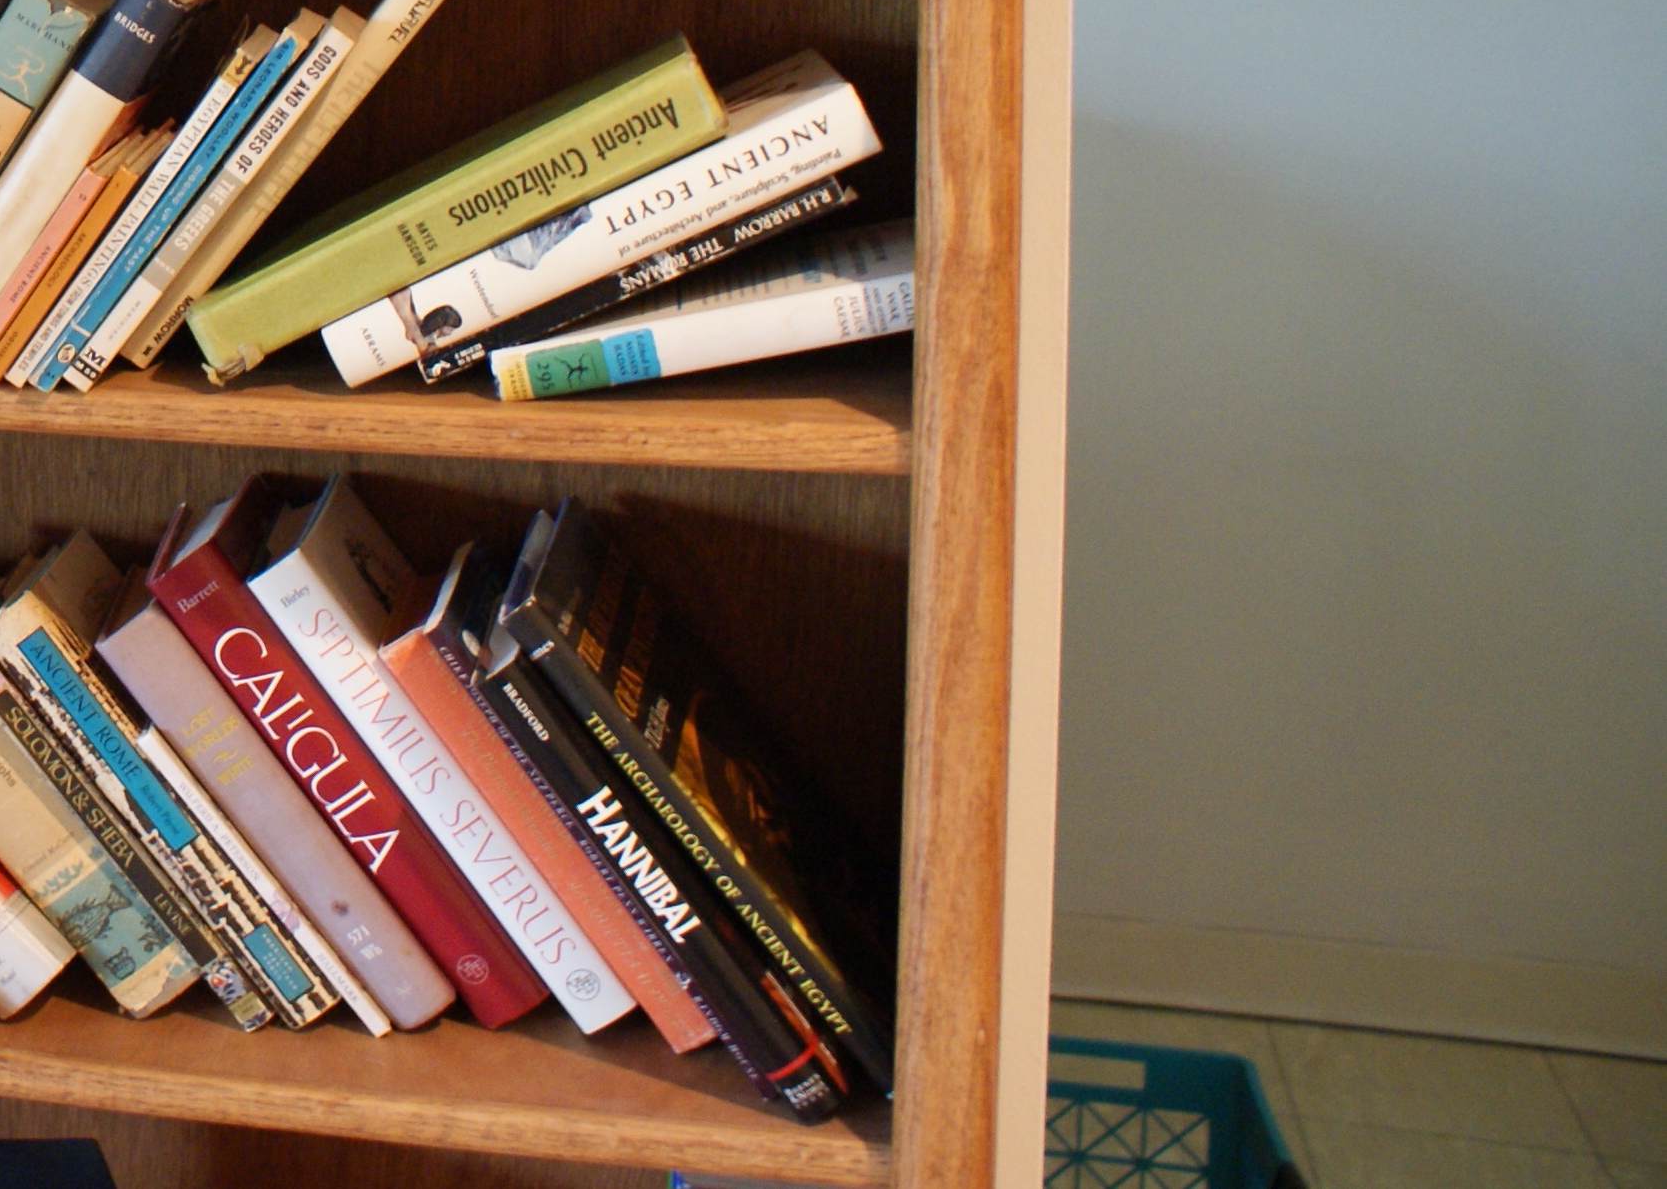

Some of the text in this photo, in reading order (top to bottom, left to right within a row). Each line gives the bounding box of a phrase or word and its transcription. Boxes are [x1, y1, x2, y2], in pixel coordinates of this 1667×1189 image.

[114, 10, 157, 45] BRIDGES
[167, 97, 223, 173] EGYPTIAN
[235, 43, 339, 175] GODS AND HEROES OF
[134, 172, 172, 212] WALL
[447, 97, 680, 227] Ancient Civilizations
[604, 114, 829, 236] ANCIENT EGYPT
[173, 176, 236, 253] THE GREEKS
[396, 222, 428, 267] HANSCOM
[415, 220, 439, 253] HAYES
[733, 202, 808, 244] BARROW
[80, 212, 140, 286] PAINTINGS
[686, 235, 725, 264] THE
[833, 295, 851, 339] CAESAR
[176, 579, 221, 613] Barrett
[279, 583, 312, 609] Birley
[31, 642, 142, 781] ANCIENT ROME
[501, 682, 550, 742] BRADFORD
[214, 626, 401, 876] CALIGULA
[4, 705, 138, 870] SOLOMON & SHEBA
[296, 607, 453, 796] SEPTIMIUS
[438, 798, 578, 968] SEVERUS
[575, 782, 703, 946] HANNIBAL
[586, 710, 621, 752] THE
[614, 750, 721, 874] ARCHAEOLOGY
[714, 872, 743, 900] OF
[736, 902, 806, 980] ANCIENT
[797, 975, 853, 1036] EGYPT
[154, 891, 191, 935] LEVINE
[346, 924, 371, 947] 571
